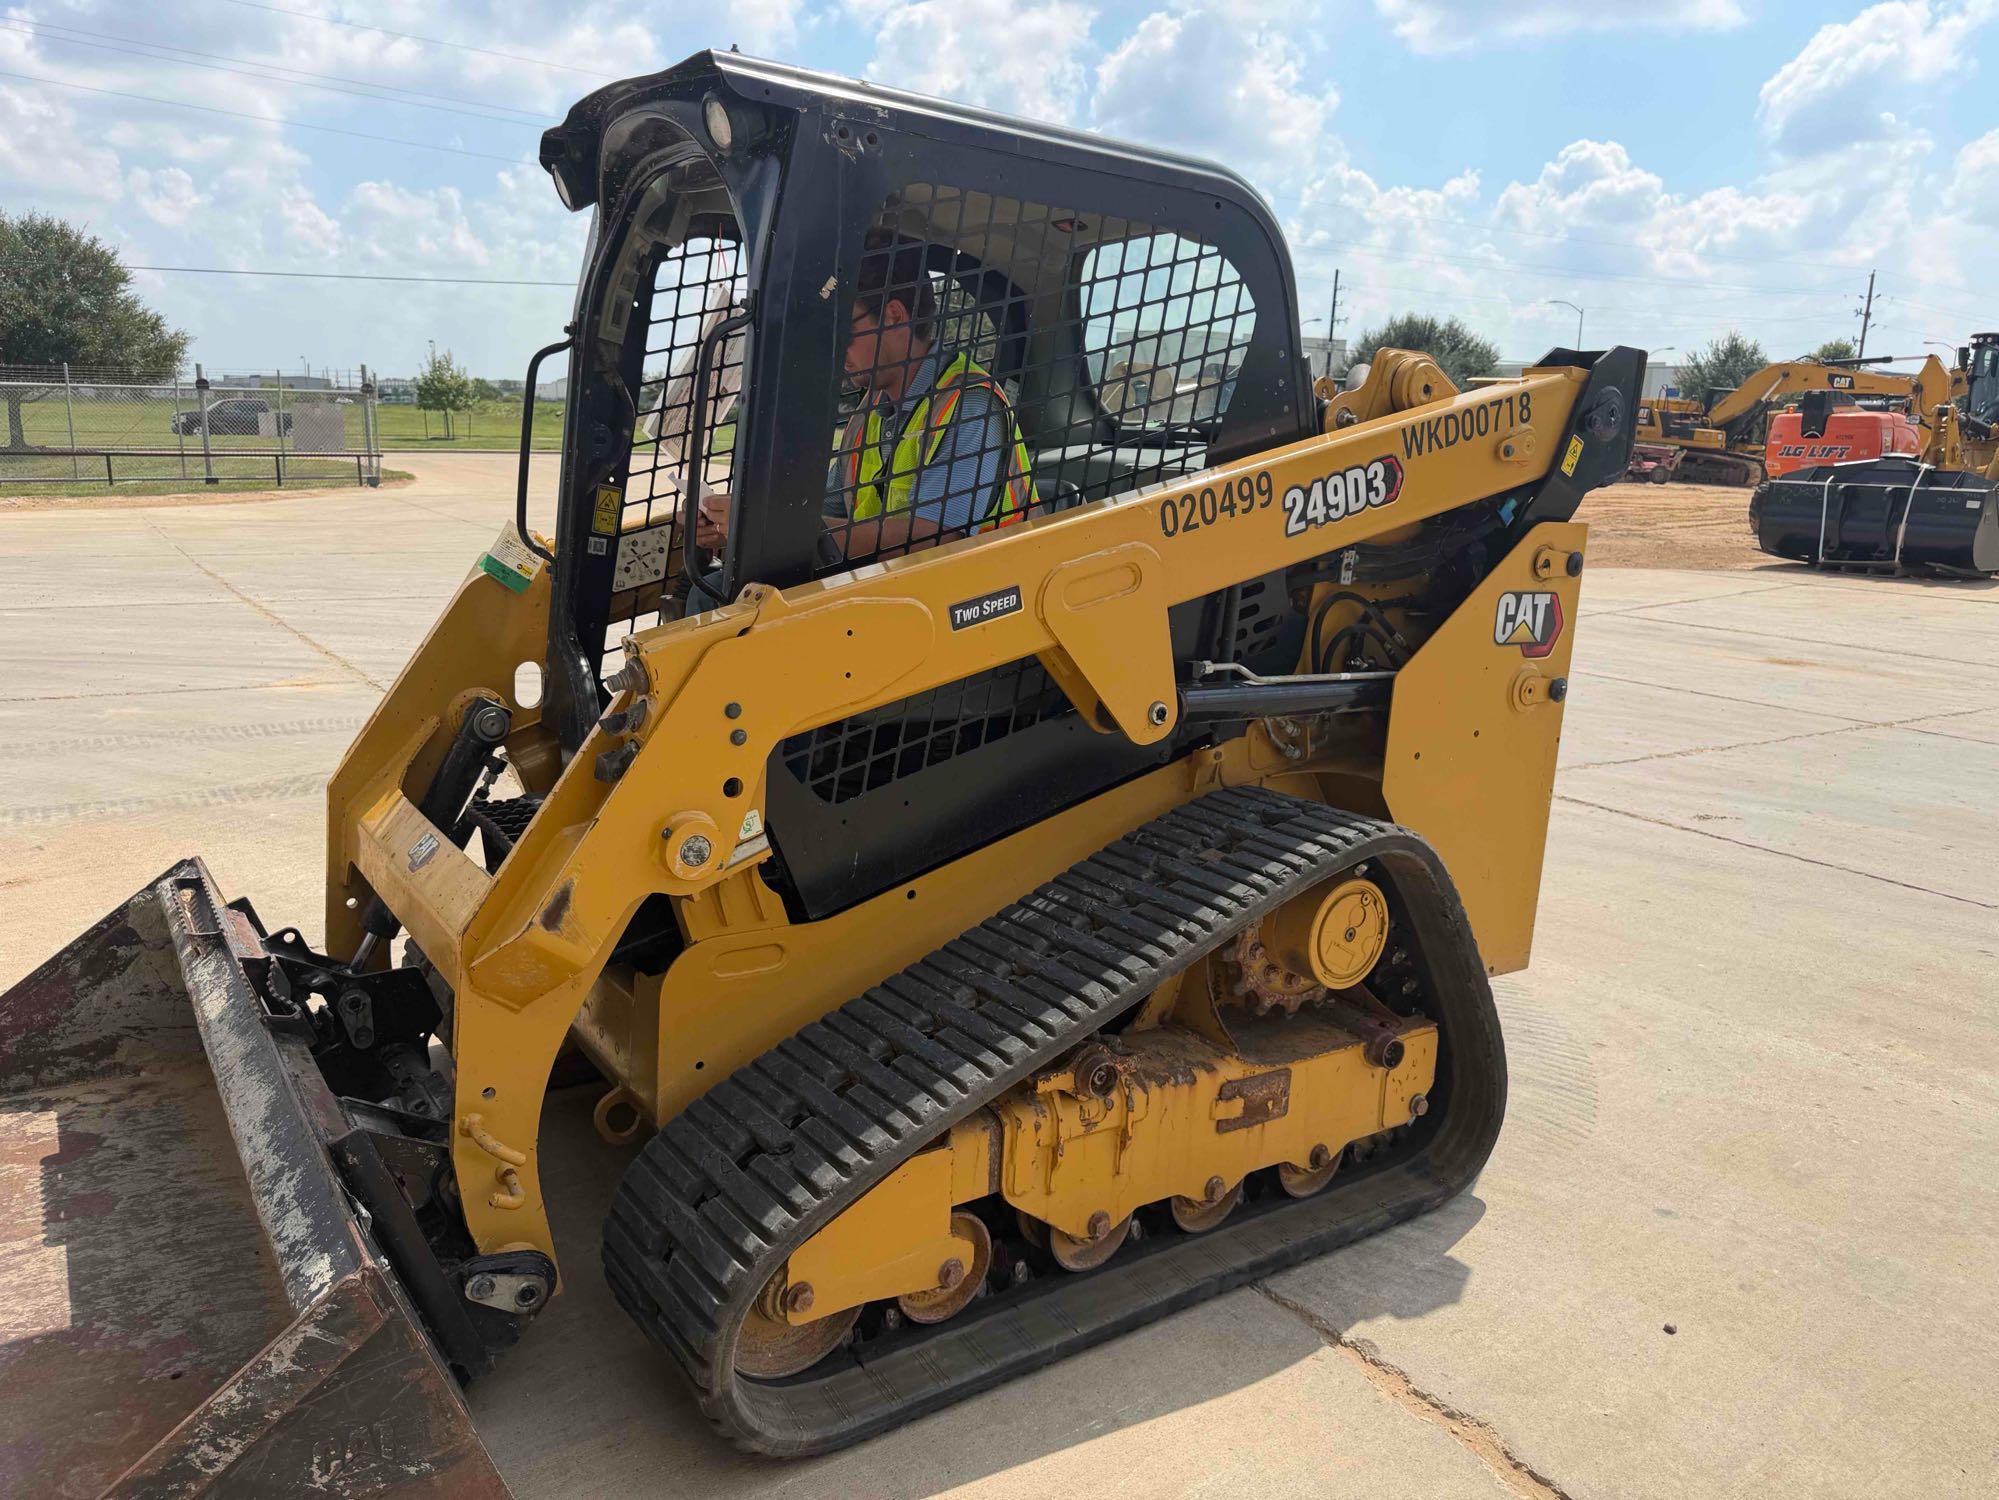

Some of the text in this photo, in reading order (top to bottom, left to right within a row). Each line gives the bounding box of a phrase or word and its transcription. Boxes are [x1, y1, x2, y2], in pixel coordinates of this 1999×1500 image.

[1833, 376, 1852, 388] CAT
[1401, 391, 1532, 460] WKD00718
[1778, 445, 1804, 458] JLG
[1807, 445, 1853, 459] LIFT
[1161, 471, 1273, 538] 020499
[1284, 461, 1388, 535] 249D3
[1494, 592, 1553, 644] CAT
